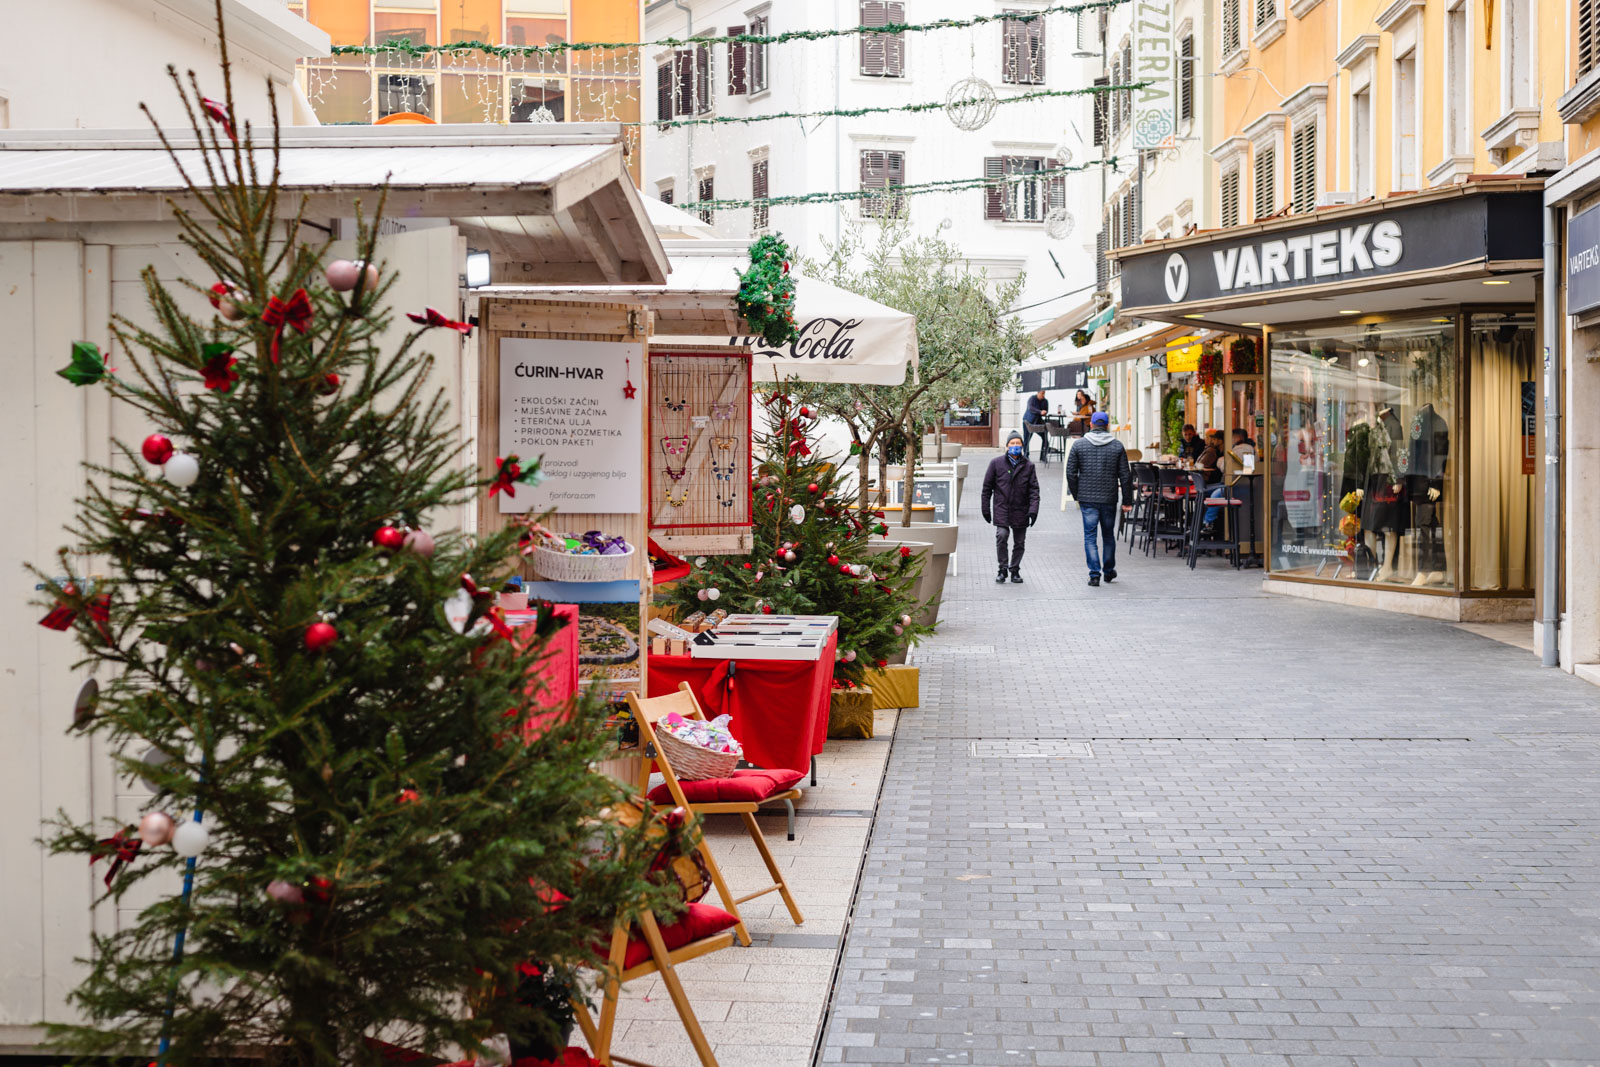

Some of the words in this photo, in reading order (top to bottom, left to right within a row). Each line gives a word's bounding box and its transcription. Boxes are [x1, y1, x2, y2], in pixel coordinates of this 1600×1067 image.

[1212, 219, 1402, 291] VARTEKS
[1569, 244, 1599, 275] VARTEKS
[514, 362, 604, 380] ĆURIN-HVAR
[521, 396, 566, 405] EKOLOŠKI
[569, 397, 599, 406] ZAČINI
[521, 406, 571, 415] MJEŠAVINE
[574, 407, 607, 416] ZAČINA
[521, 417, 566, 426] ETERIČNA
[569, 418, 592, 426] ULJA
[521, 427, 568, 436] PRIRODNA
[571, 428, 622, 437] KOZMETIKA
[521, 437, 559, 446] POKLON
[562, 438, 594, 446] PAKETI
[573, 471, 610, 480] uzgojenog
[611, 470, 627, 480] bilja
